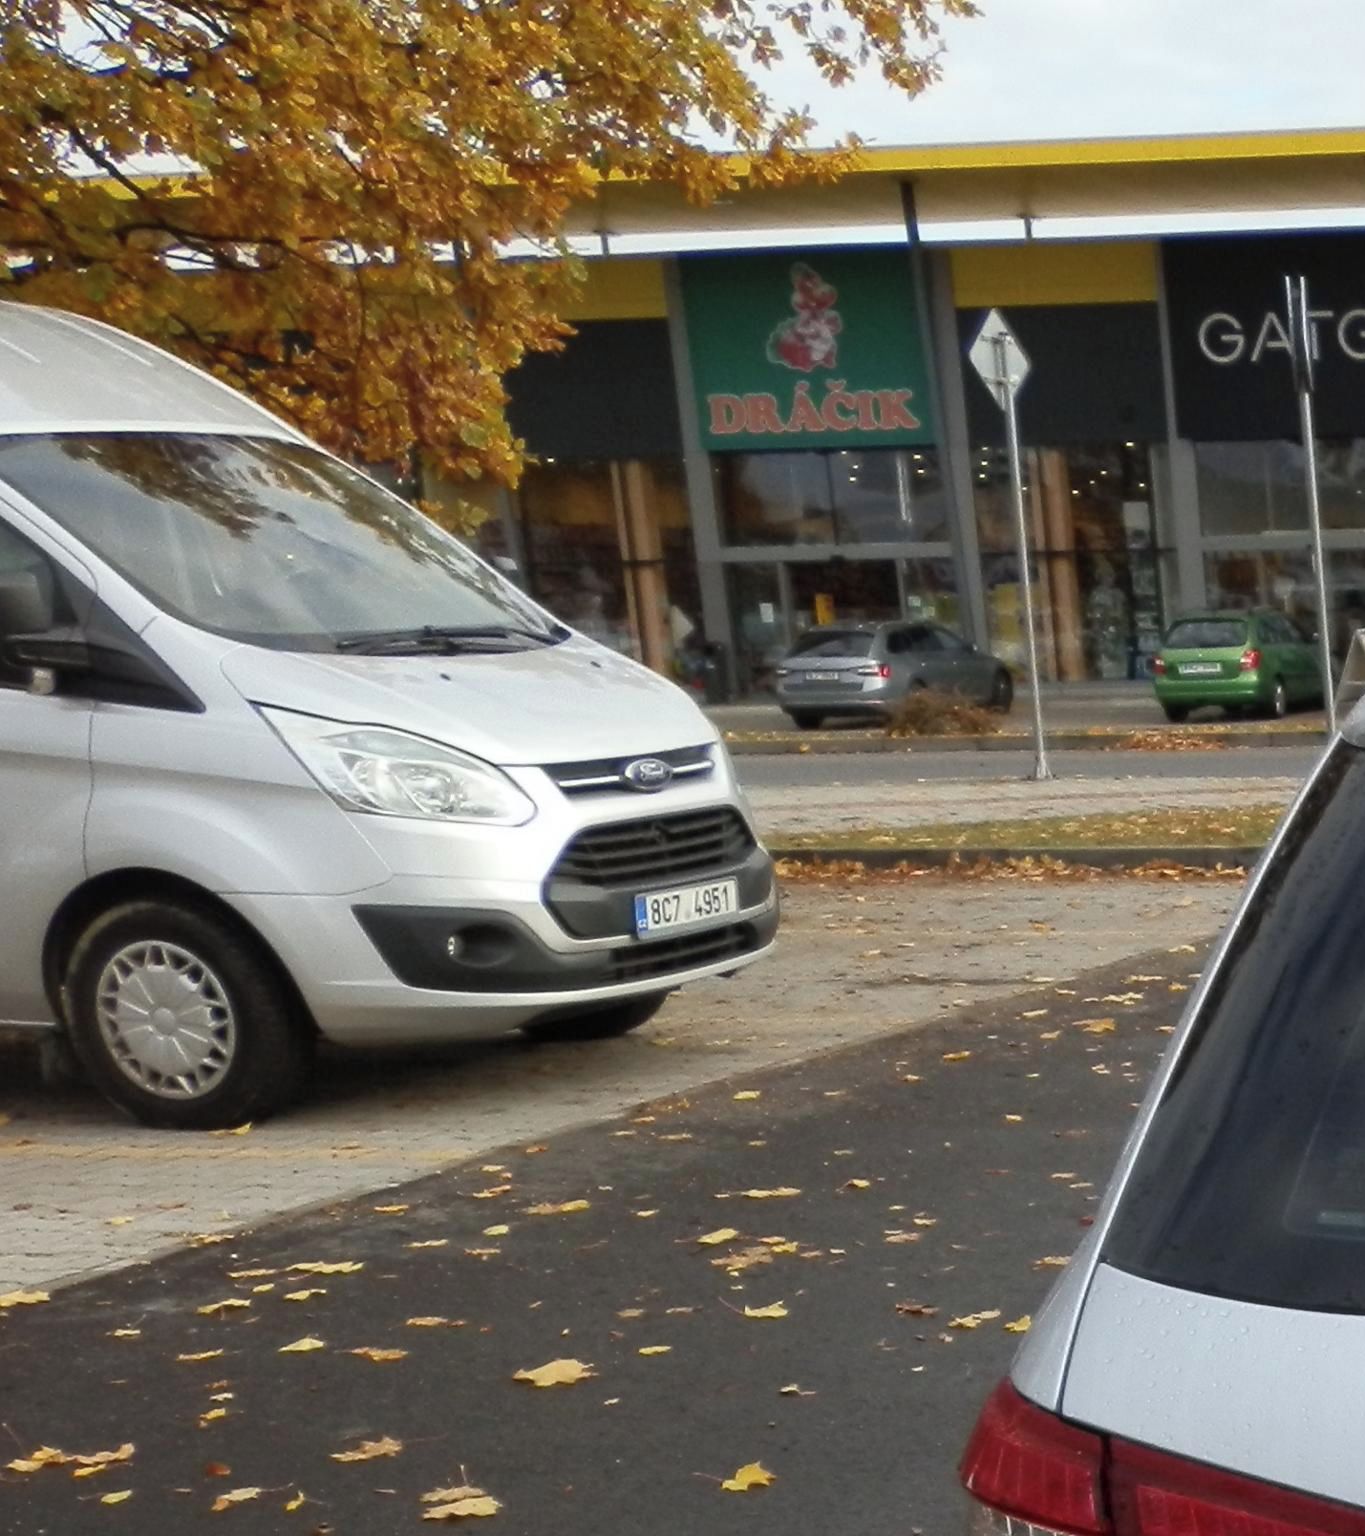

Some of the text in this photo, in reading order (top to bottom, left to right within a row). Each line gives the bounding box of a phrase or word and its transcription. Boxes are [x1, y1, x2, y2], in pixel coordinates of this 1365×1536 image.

[708, 379, 921, 436] DRÁČIK
[650, 885, 730, 925] 8C7 4951
